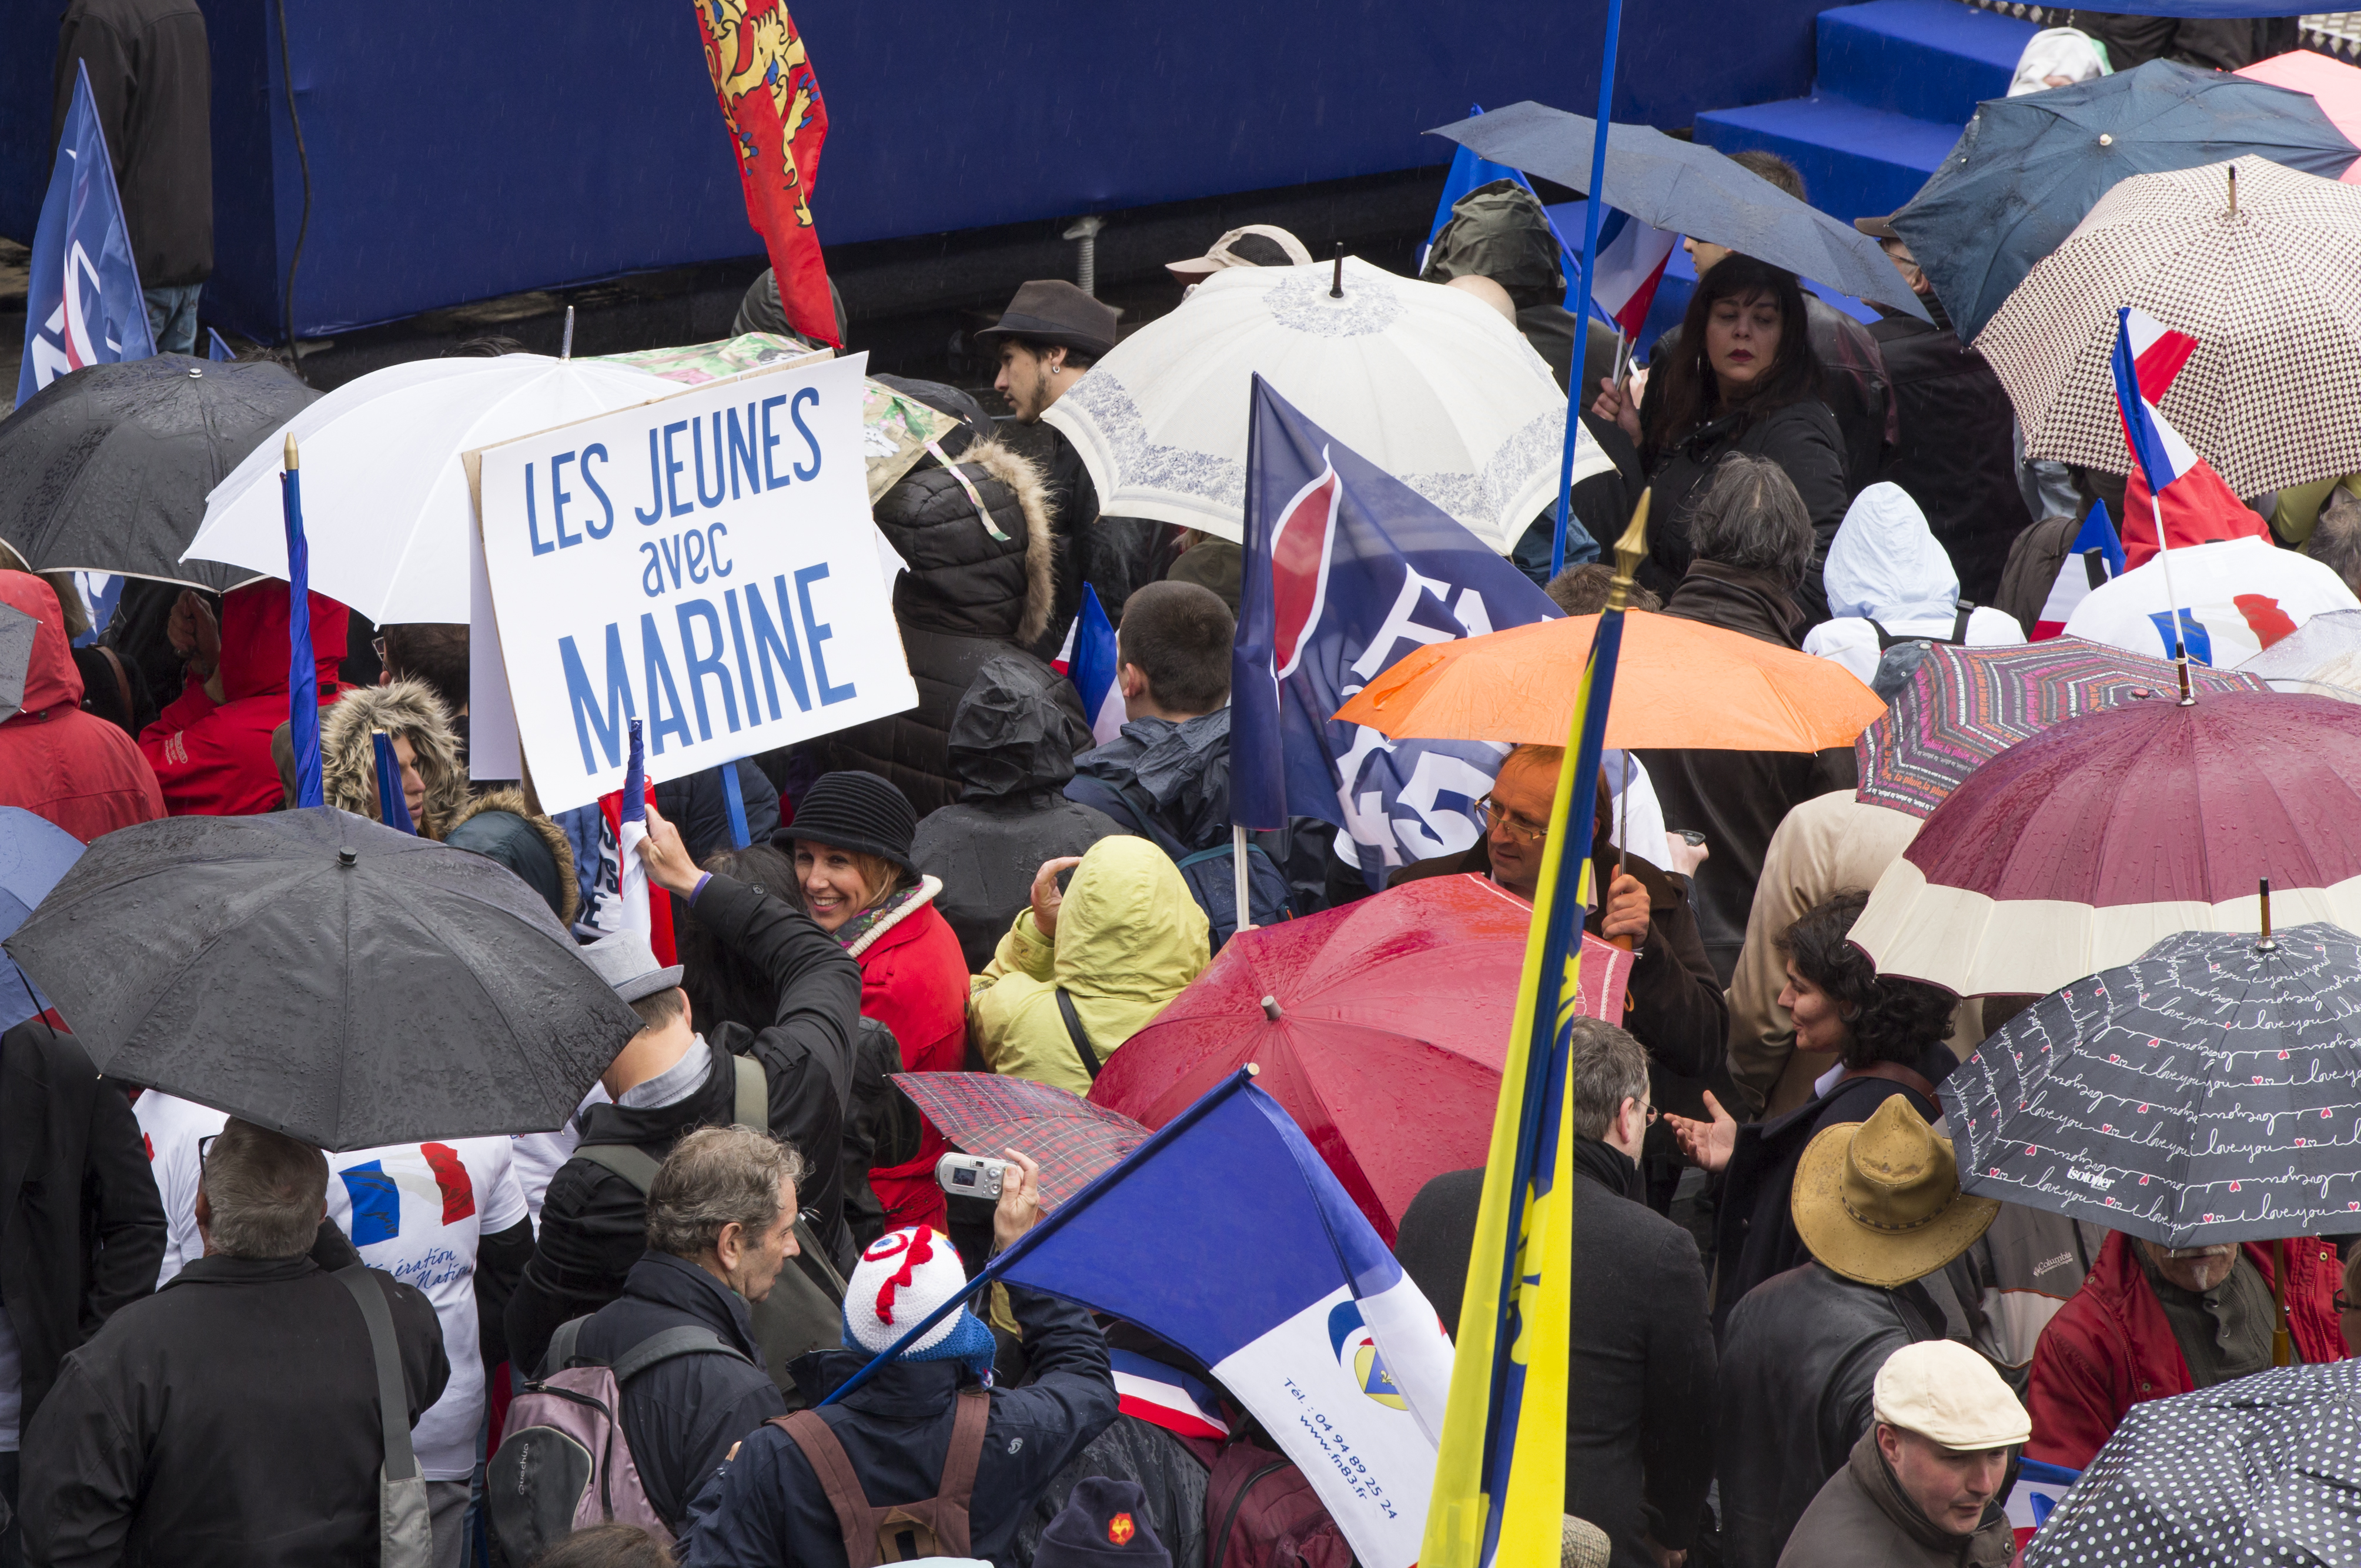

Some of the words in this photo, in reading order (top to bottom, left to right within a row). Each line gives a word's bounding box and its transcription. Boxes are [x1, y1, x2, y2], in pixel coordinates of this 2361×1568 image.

[526, 443, 614, 557] LES
[634, 387, 822, 526] JEUNES
[639, 522, 733, 597] avec
[558, 562, 857, 776] MARINE
[2067, 1166, 2115, 1188] isotoner
[2038, 1251, 2072, 1271] Columbia
[518, 1443, 529, 1495] Quechua
[1284, 1377, 1306, 1404] Tél.
[1315, 1414, 1333, 1432] 04
[1333, 1434, 1350, 1453] 94
[1349, 1456, 1366, 1473] 89
[1365, 1477, 1383, 1496] 25
[1380, 1499, 1397, 1519] 24
[1300, 1415, 1367, 1500] www.fn83.fr
